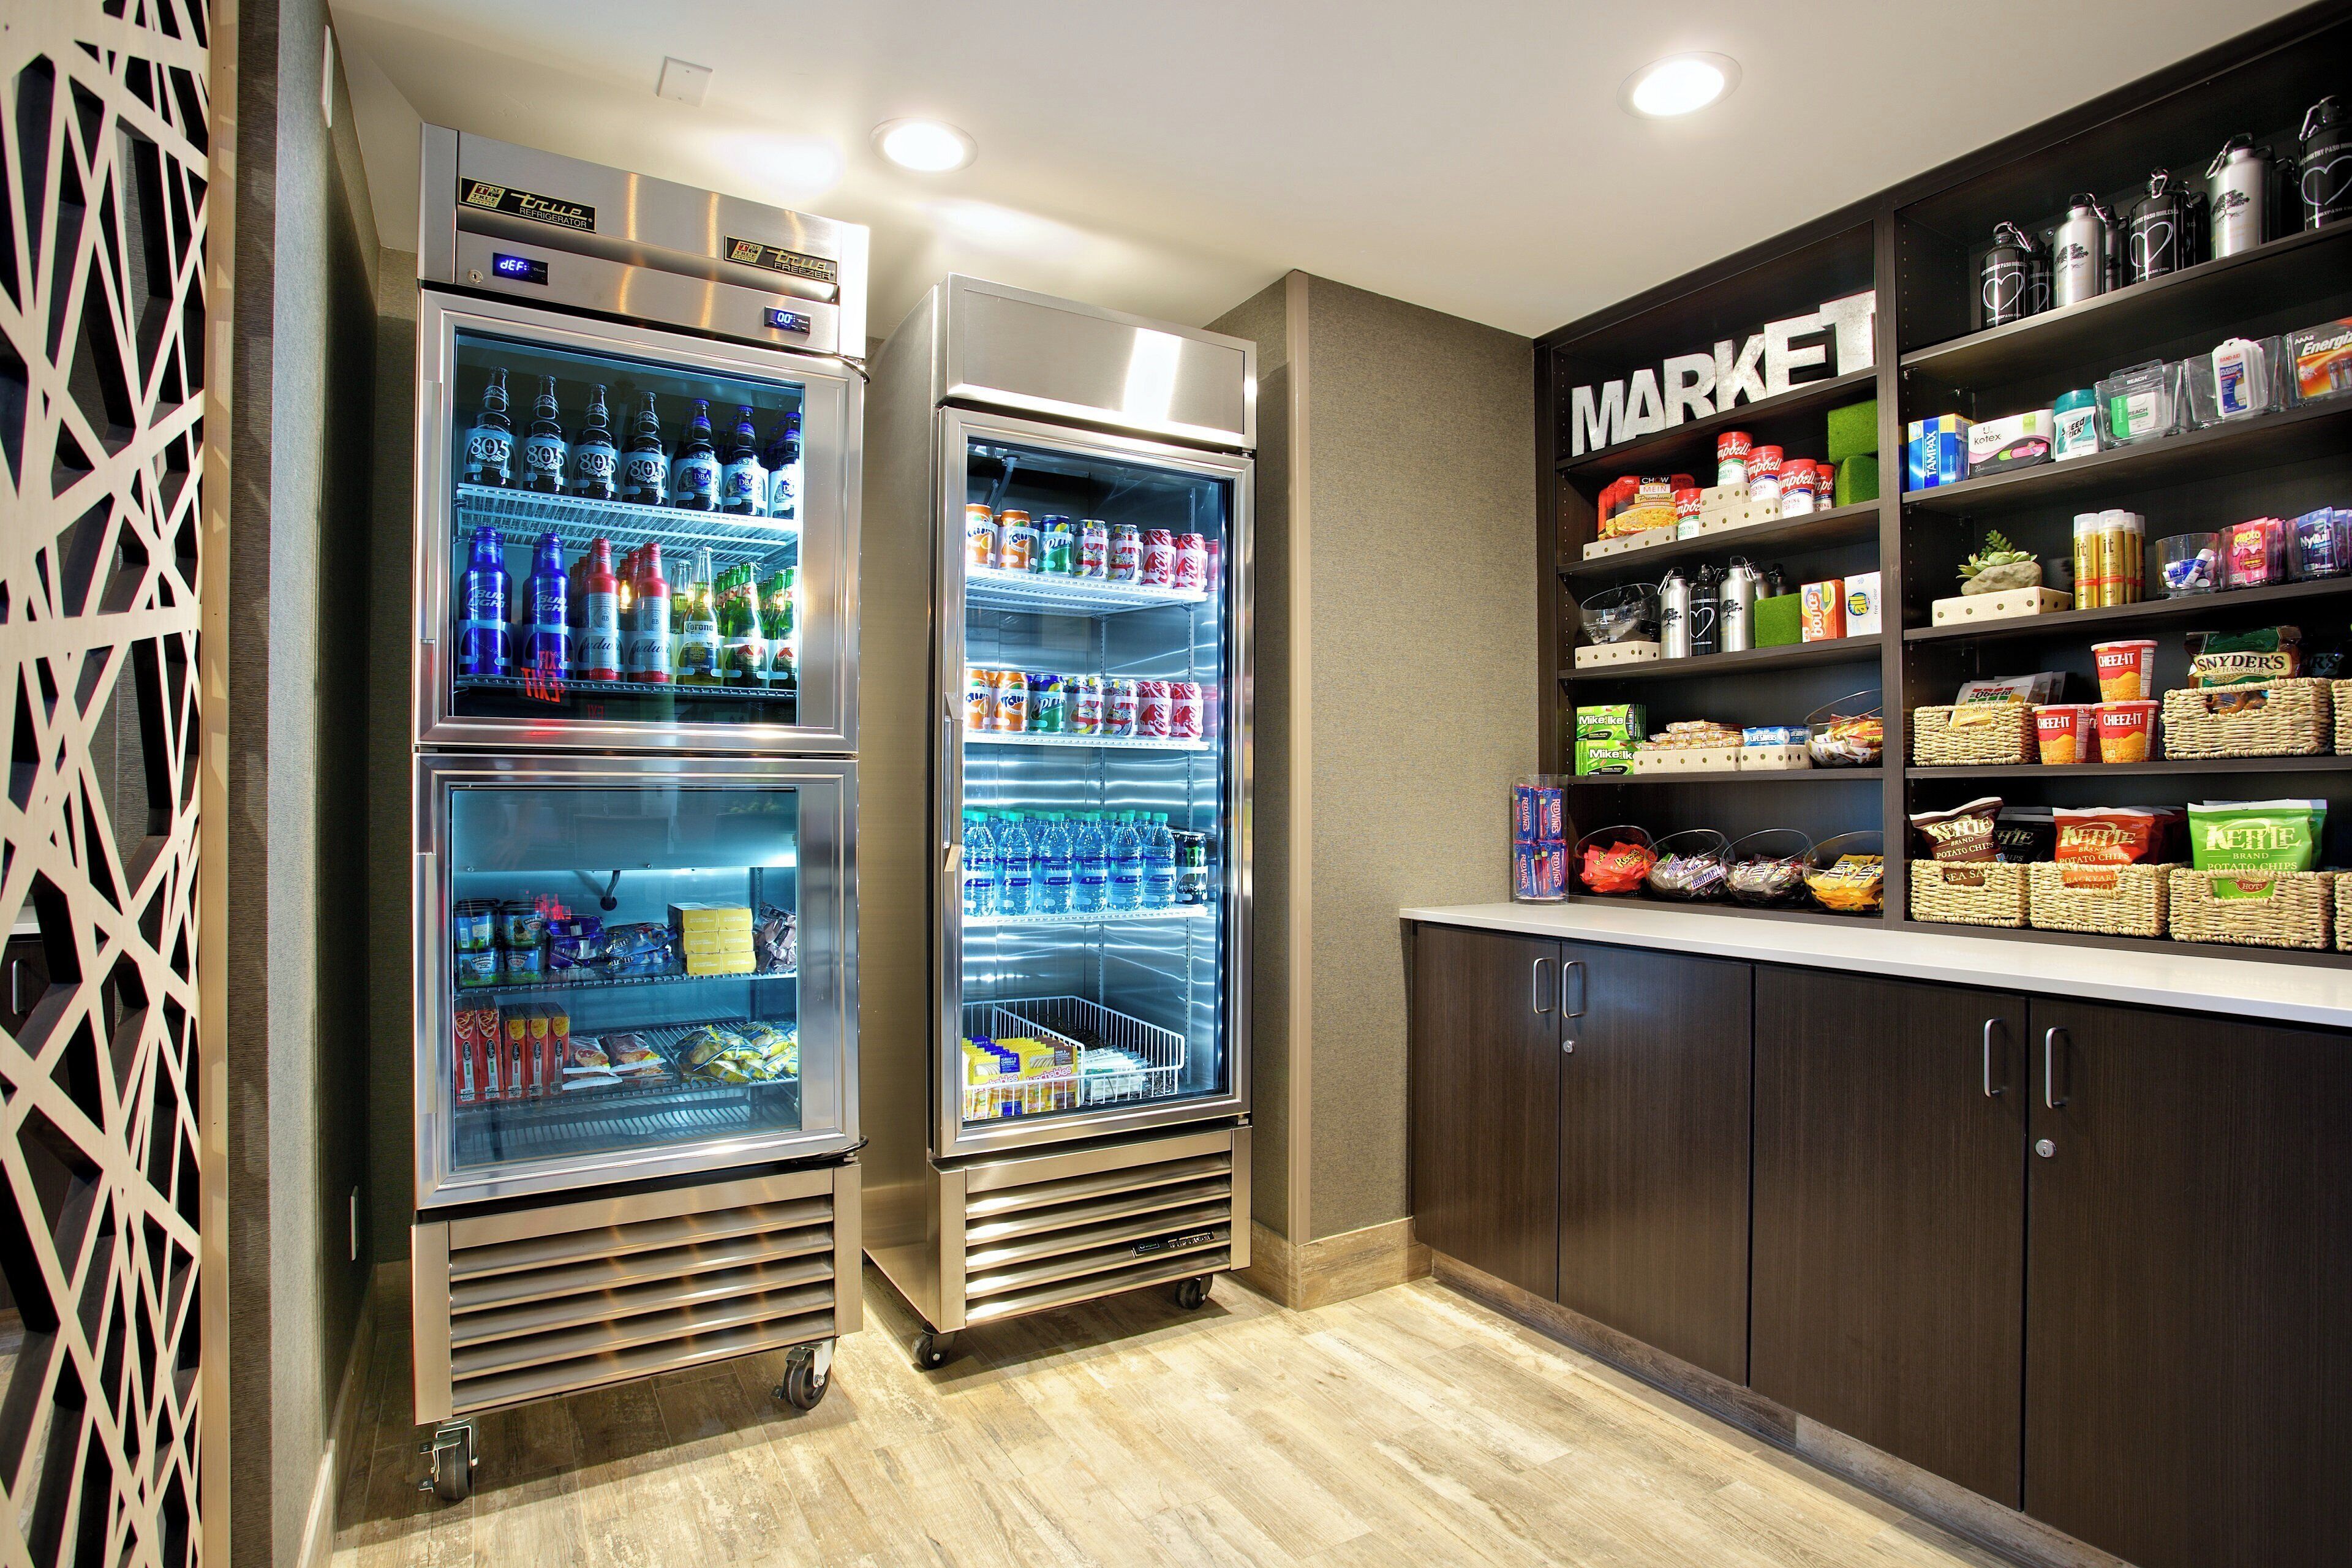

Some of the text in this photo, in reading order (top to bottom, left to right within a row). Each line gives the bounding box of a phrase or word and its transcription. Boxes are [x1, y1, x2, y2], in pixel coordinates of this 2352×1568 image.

[2325, 144, 2340, 154] PASO
[519, 207, 587, 228] REFRIGERATOR
[2144, 212, 2155, 221] PASO
[774, 262, 831, 280] FREEZER
[1572, 290, 1876, 458] MARKET
[2127, 375, 2148, 385] REACH
[2128, 407, 2148, 417] REACH
[1974, 433, 2002, 446] kotex
[471, 438, 510, 459] 805
[1926, 429, 1937, 479] TAMPAX
[526, 447, 564, 467] 805
[1637, 493, 1673, 502] Premium
[2300, 529, 2331, 549] NyQuil
[1849, 595, 1868, 615] all
[1811, 592, 1826, 638] bounce
[685, 622, 713, 631] Corona
[2098, 652, 2135, 668] CHEEZ-IT
[2197, 654, 2285, 671] SNYDER'S
[1975, 690, 2012, 699] Oberto
[1578, 715, 1605, 726] Mike
[1607, 715, 1624, 725] Ike
[2037, 716, 2070, 729] CHEEZ-IT
[2103, 712, 2143, 726] CHEEZ-IT
[1589, 748, 1619, 759] Mike
[1623, 750, 1634, 760] Ik
[1926, 815, 1994, 845] KETTLE
[2058, 821, 2137, 849] KETTLE
[2203, 818, 2302, 851] KETTLE
[1950, 836, 1974, 846] BRAND
[1936, 841, 1994, 859] POTATO CHIPS
[1614, 848, 1640, 869] Reese's
[2059, 853, 2130, 864] POTATO CHIPS
[2207, 861, 2298, 871] POTATO CHIPS
[1945, 872, 1967, 883] SEA
